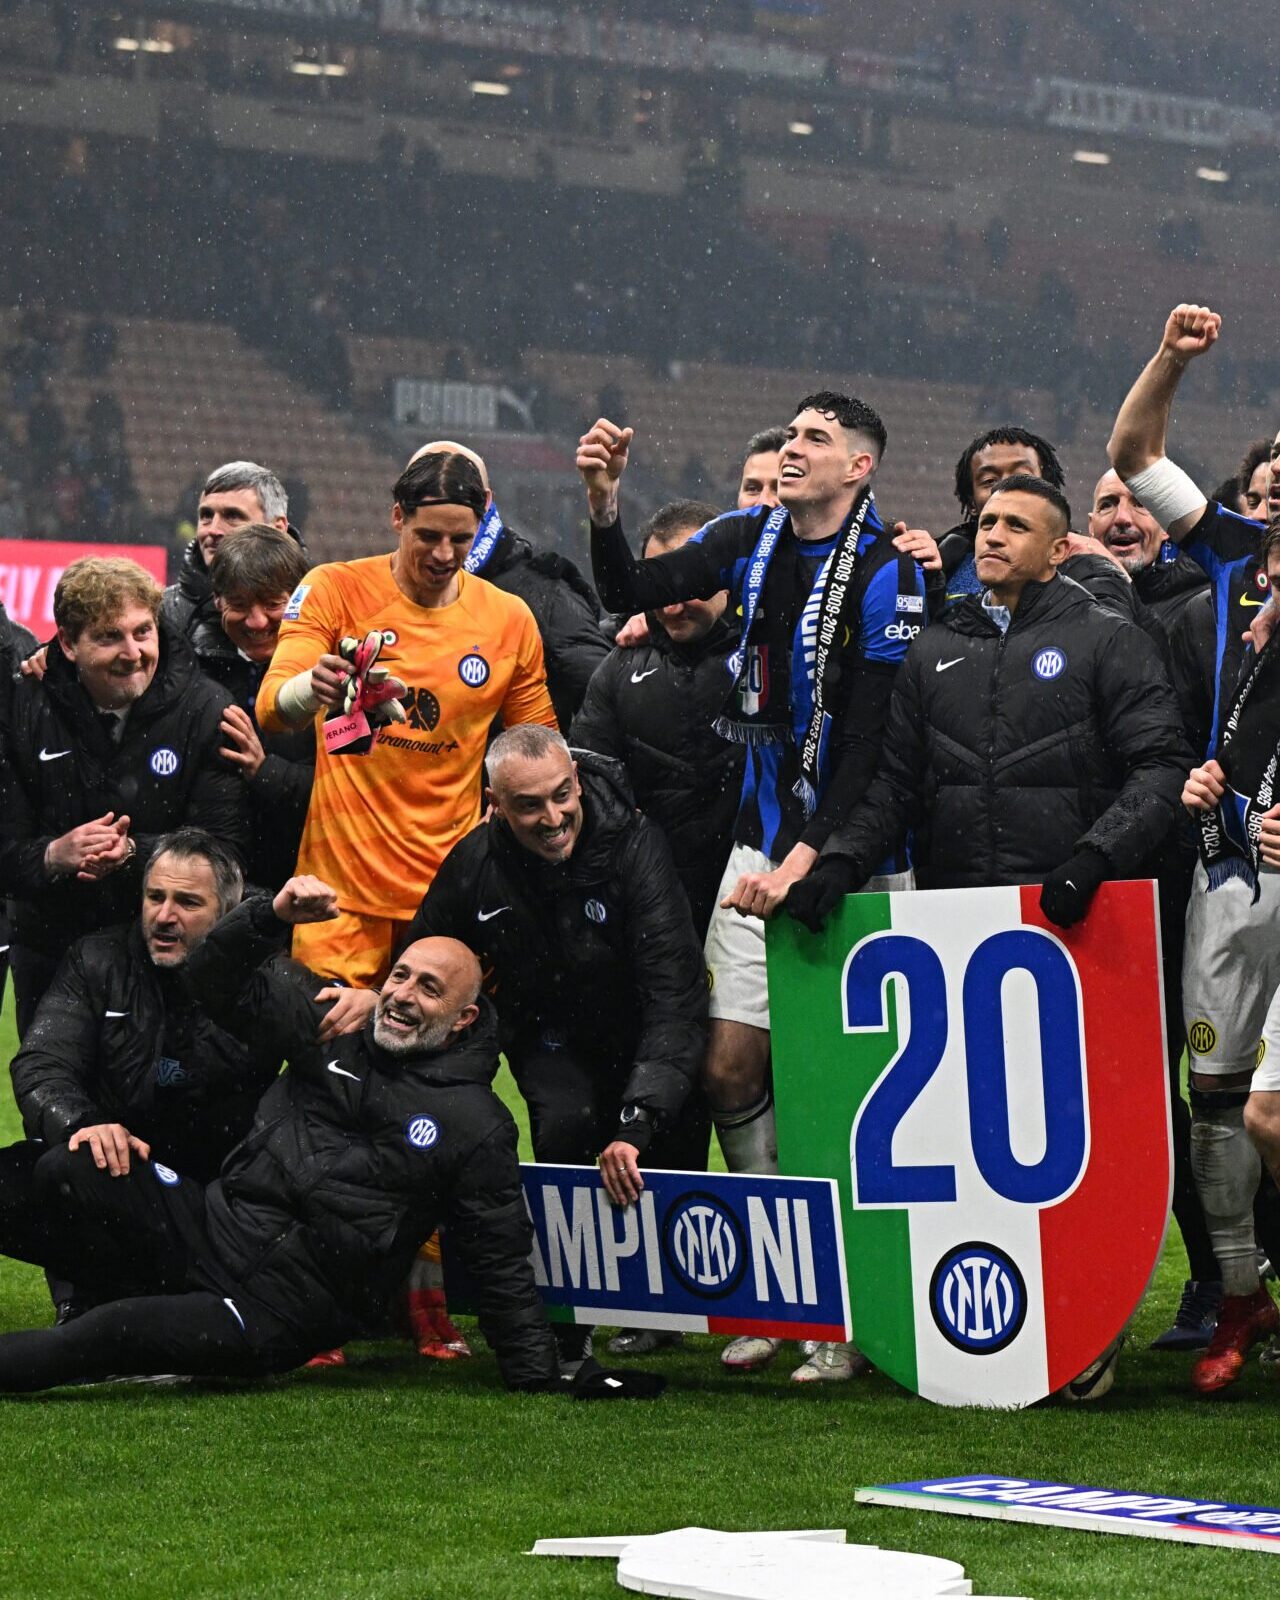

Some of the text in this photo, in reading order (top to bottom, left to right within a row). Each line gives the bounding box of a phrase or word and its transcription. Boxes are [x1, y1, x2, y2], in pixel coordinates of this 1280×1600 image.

[747, 532, 777, 589] 1988-1989
[833, 522, 861, 582] 2008-2009
[819, 582, 848, 645] 2009-2010
[884, 619, 924, 641] eba
[897, 596, 909, 608] 95
[376, 729, 460, 755] aramount+
[802, 706, 823, 772] 2023-2024
[841, 924, 1092, 1210] 20
